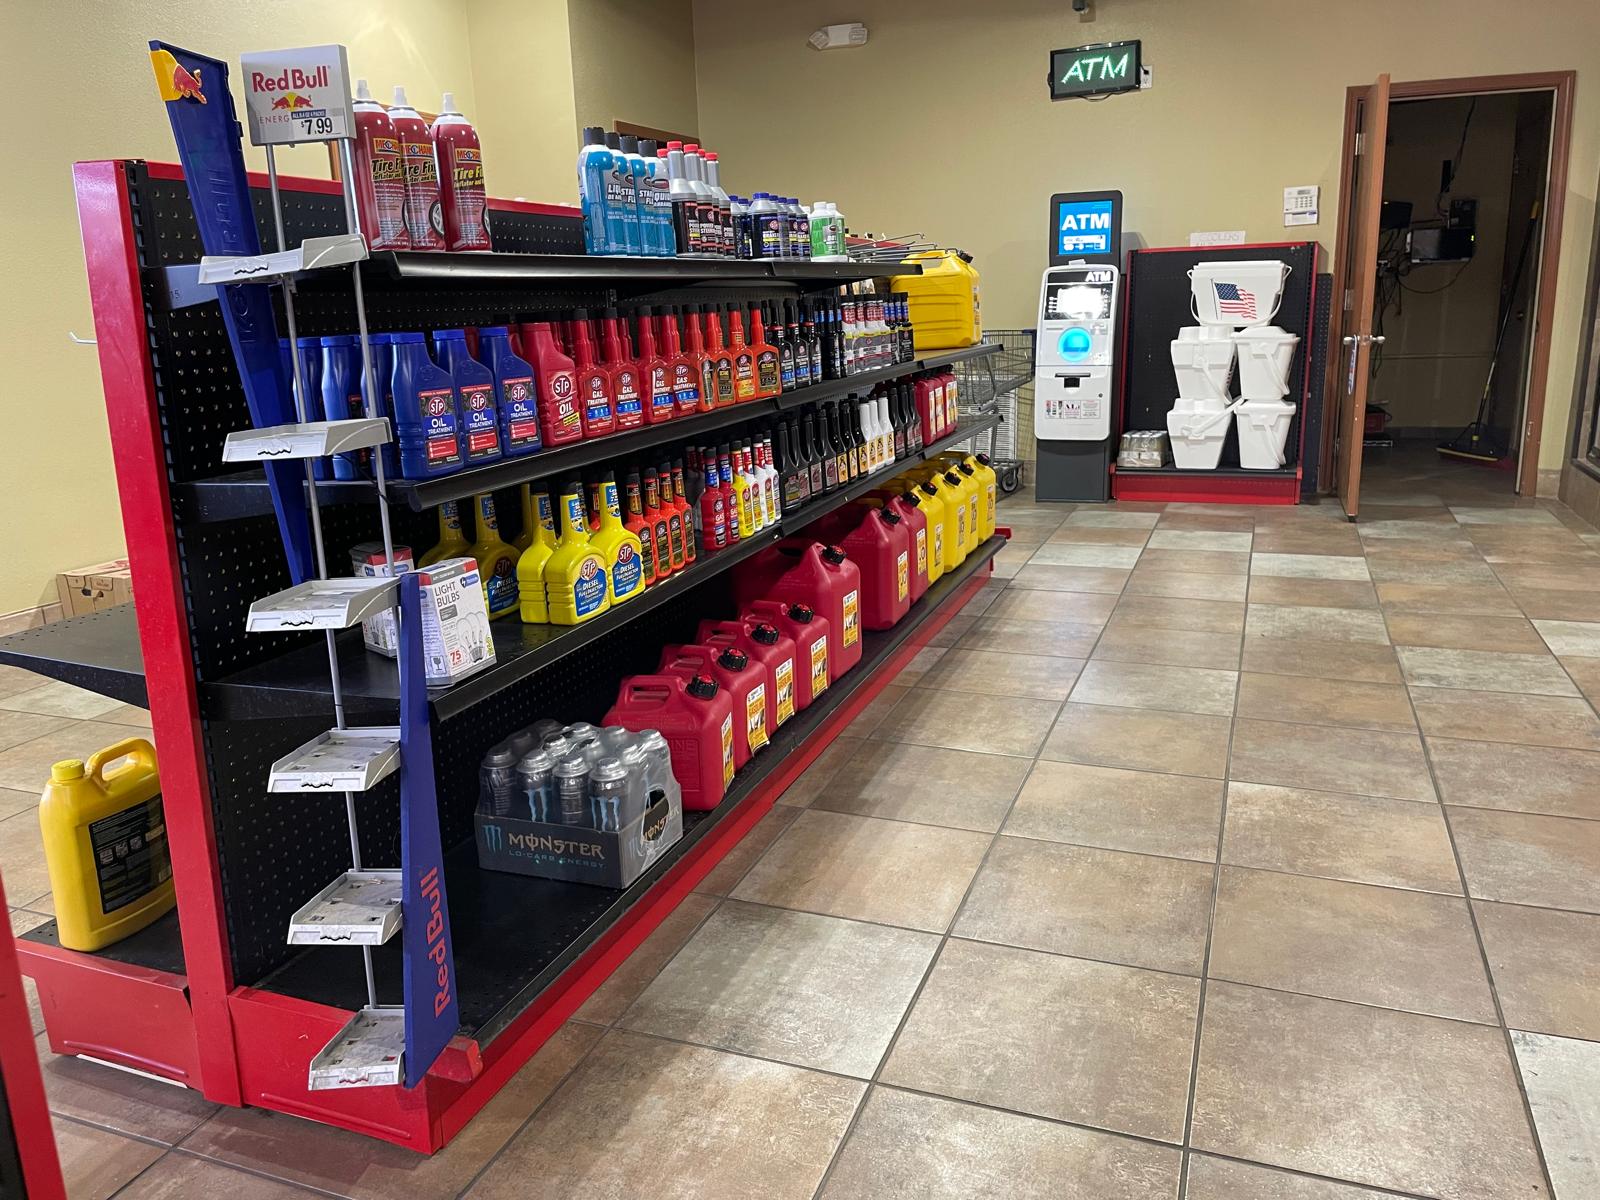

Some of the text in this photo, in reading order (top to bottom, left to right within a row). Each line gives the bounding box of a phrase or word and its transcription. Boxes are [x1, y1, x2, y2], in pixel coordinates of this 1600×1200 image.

[1061, 53, 1129, 84] ATM
[251, 66, 328, 92] Red Bull
[372, 159, 394, 173] Tire
[454, 167, 474, 180] Tire
[1062, 212, 1110, 231] ATM
[1085, 270, 1111, 282] ATM
[676, 366, 688, 375] STP
[555, 378, 570, 394] STP
[592, 377, 602, 389] STP
[656, 380, 665, 388] GAS
[676, 376, 688, 384] GAS
[513, 386, 525, 400] STP
[592, 390, 603, 398] GAS
[622, 386, 632, 394] GAS
[430, 399, 444, 414] STP
[471, 394, 486, 409] STP
[514, 403, 528, 412] OIL
[560, 402, 573, 414] OIL
[431, 418, 447, 428] OIL
[472, 412, 488, 422] OIL
[428, 426, 453, 435] TREATMENT
[469, 421, 493, 430] TREATMENT
[619, 546, 632, 562] STP
[496, 559, 512, 577] STP
[582, 562, 596, 579] STP
[620, 563, 634, 575] DIESEL
[434, 581, 457, 597] LIGHT
[582, 578, 598, 590] DIESEL
[437, 592, 460, 608] BULBS
[450, 650, 462, 663] 75
[508, 832, 605, 860] MONSTER
[508, 850, 606, 868] LO-CARB ENERGY
[419, 865, 451, 1019] Red Bull
